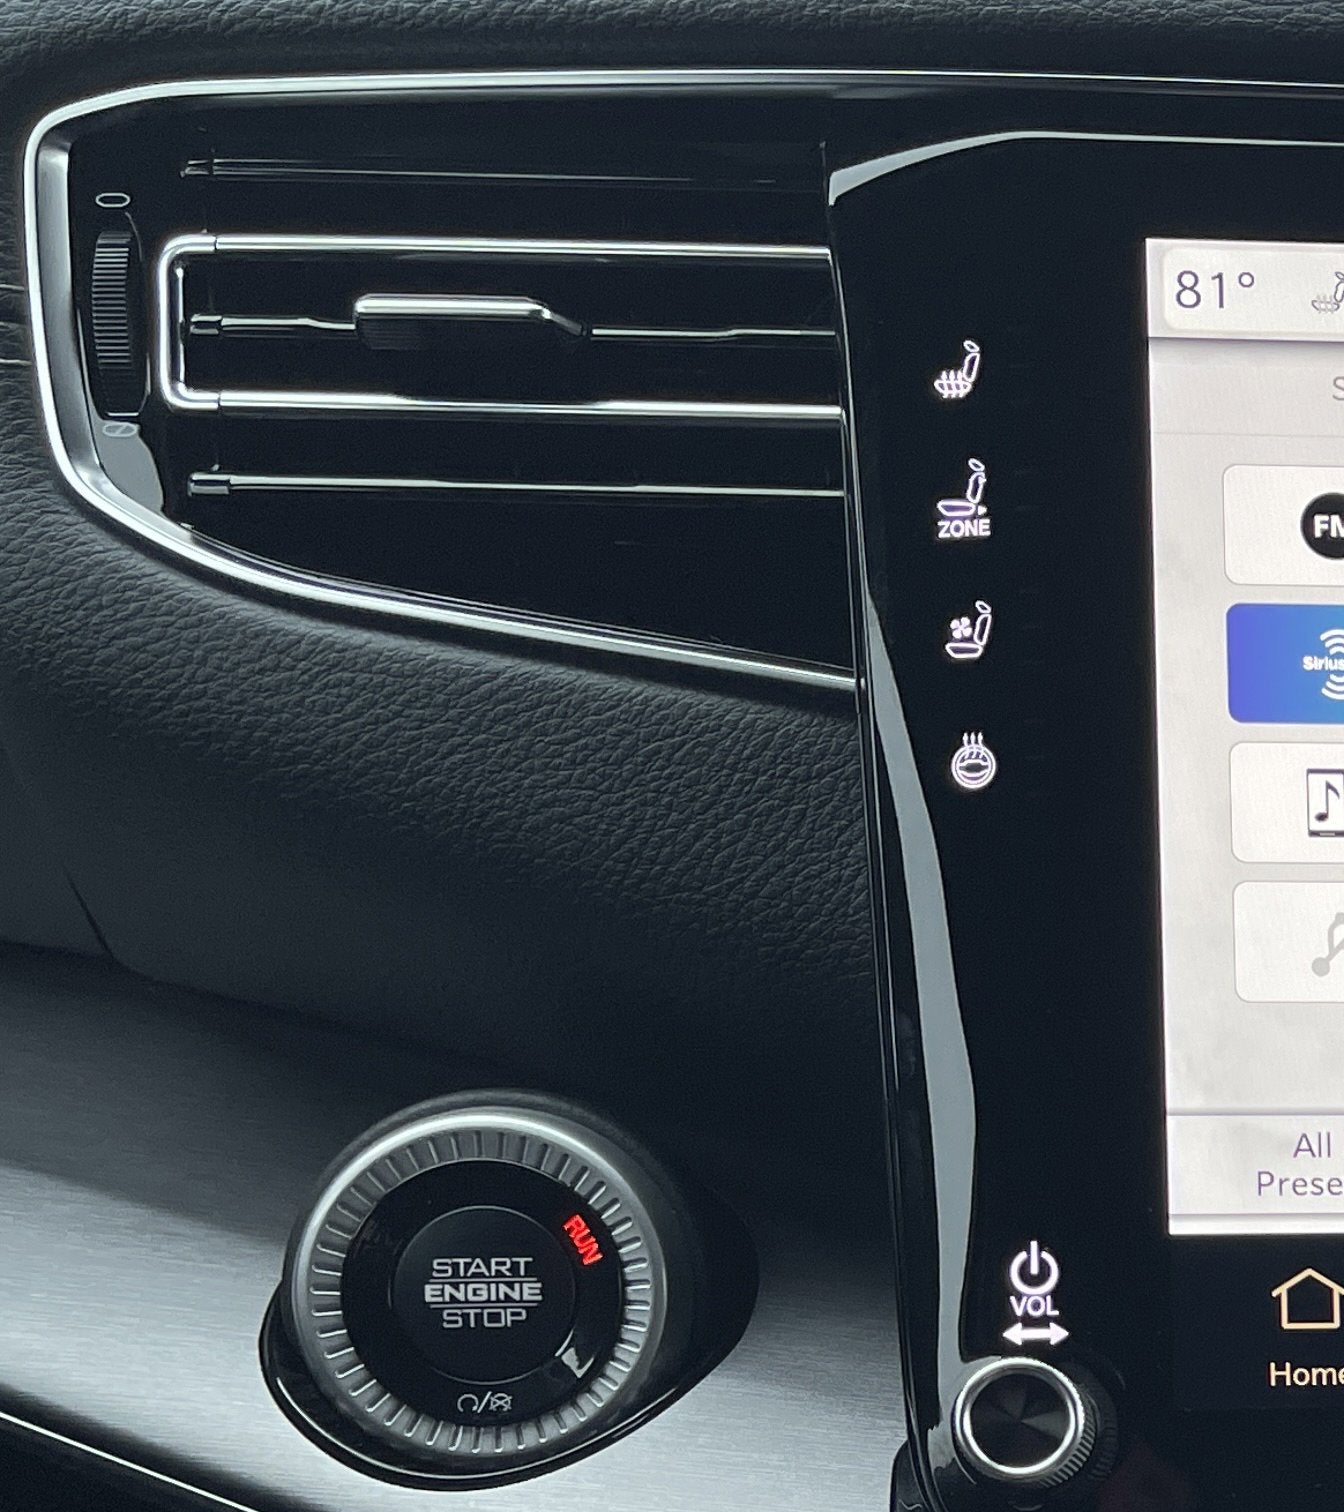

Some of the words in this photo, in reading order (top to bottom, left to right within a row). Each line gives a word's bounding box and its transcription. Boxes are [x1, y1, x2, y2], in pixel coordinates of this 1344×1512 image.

[1175, 271, 1255, 310] 81°
[937, 518, 991, 539] ZONE
[1293, 1132, 1334, 1160] All
[562, 1214, 603, 1266] RUN
[432, 1257, 533, 1278] START
[424, 1282, 543, 1303] ENGINE
[1010, 1295, 1060, 1317] VOL
[442, 1308, 527, 1328] STOP
